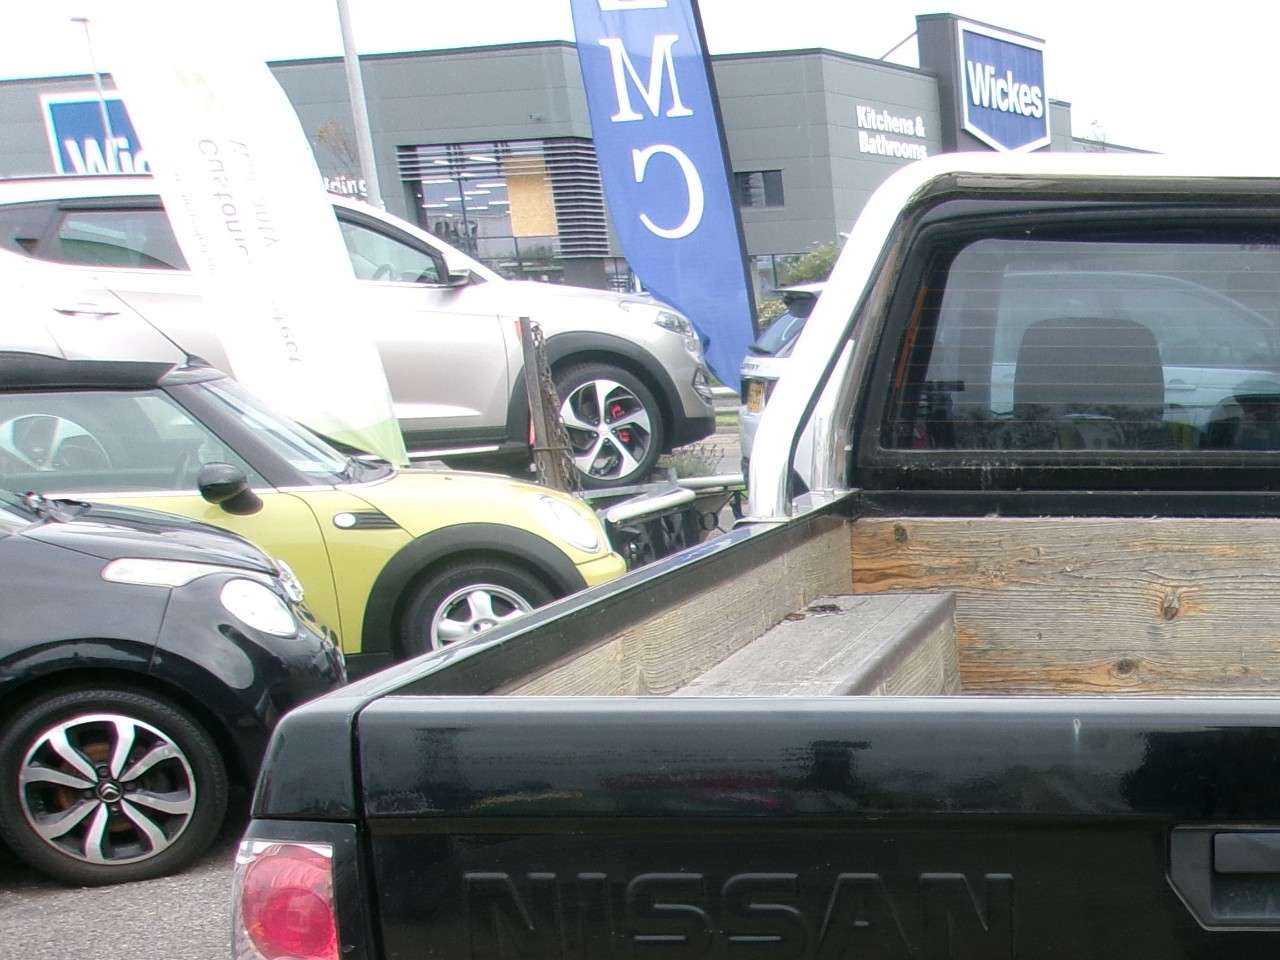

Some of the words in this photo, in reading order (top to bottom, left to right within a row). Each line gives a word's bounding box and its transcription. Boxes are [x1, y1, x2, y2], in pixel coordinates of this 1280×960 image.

[967, 60, 1044, 119] Wickes
[856, 105, 915, 138] Kitchens
[915, 115, 926, 138] &
[858, 131, 927, 160] Bathrooms
[462, 871, 1015, 960] NISSAN
